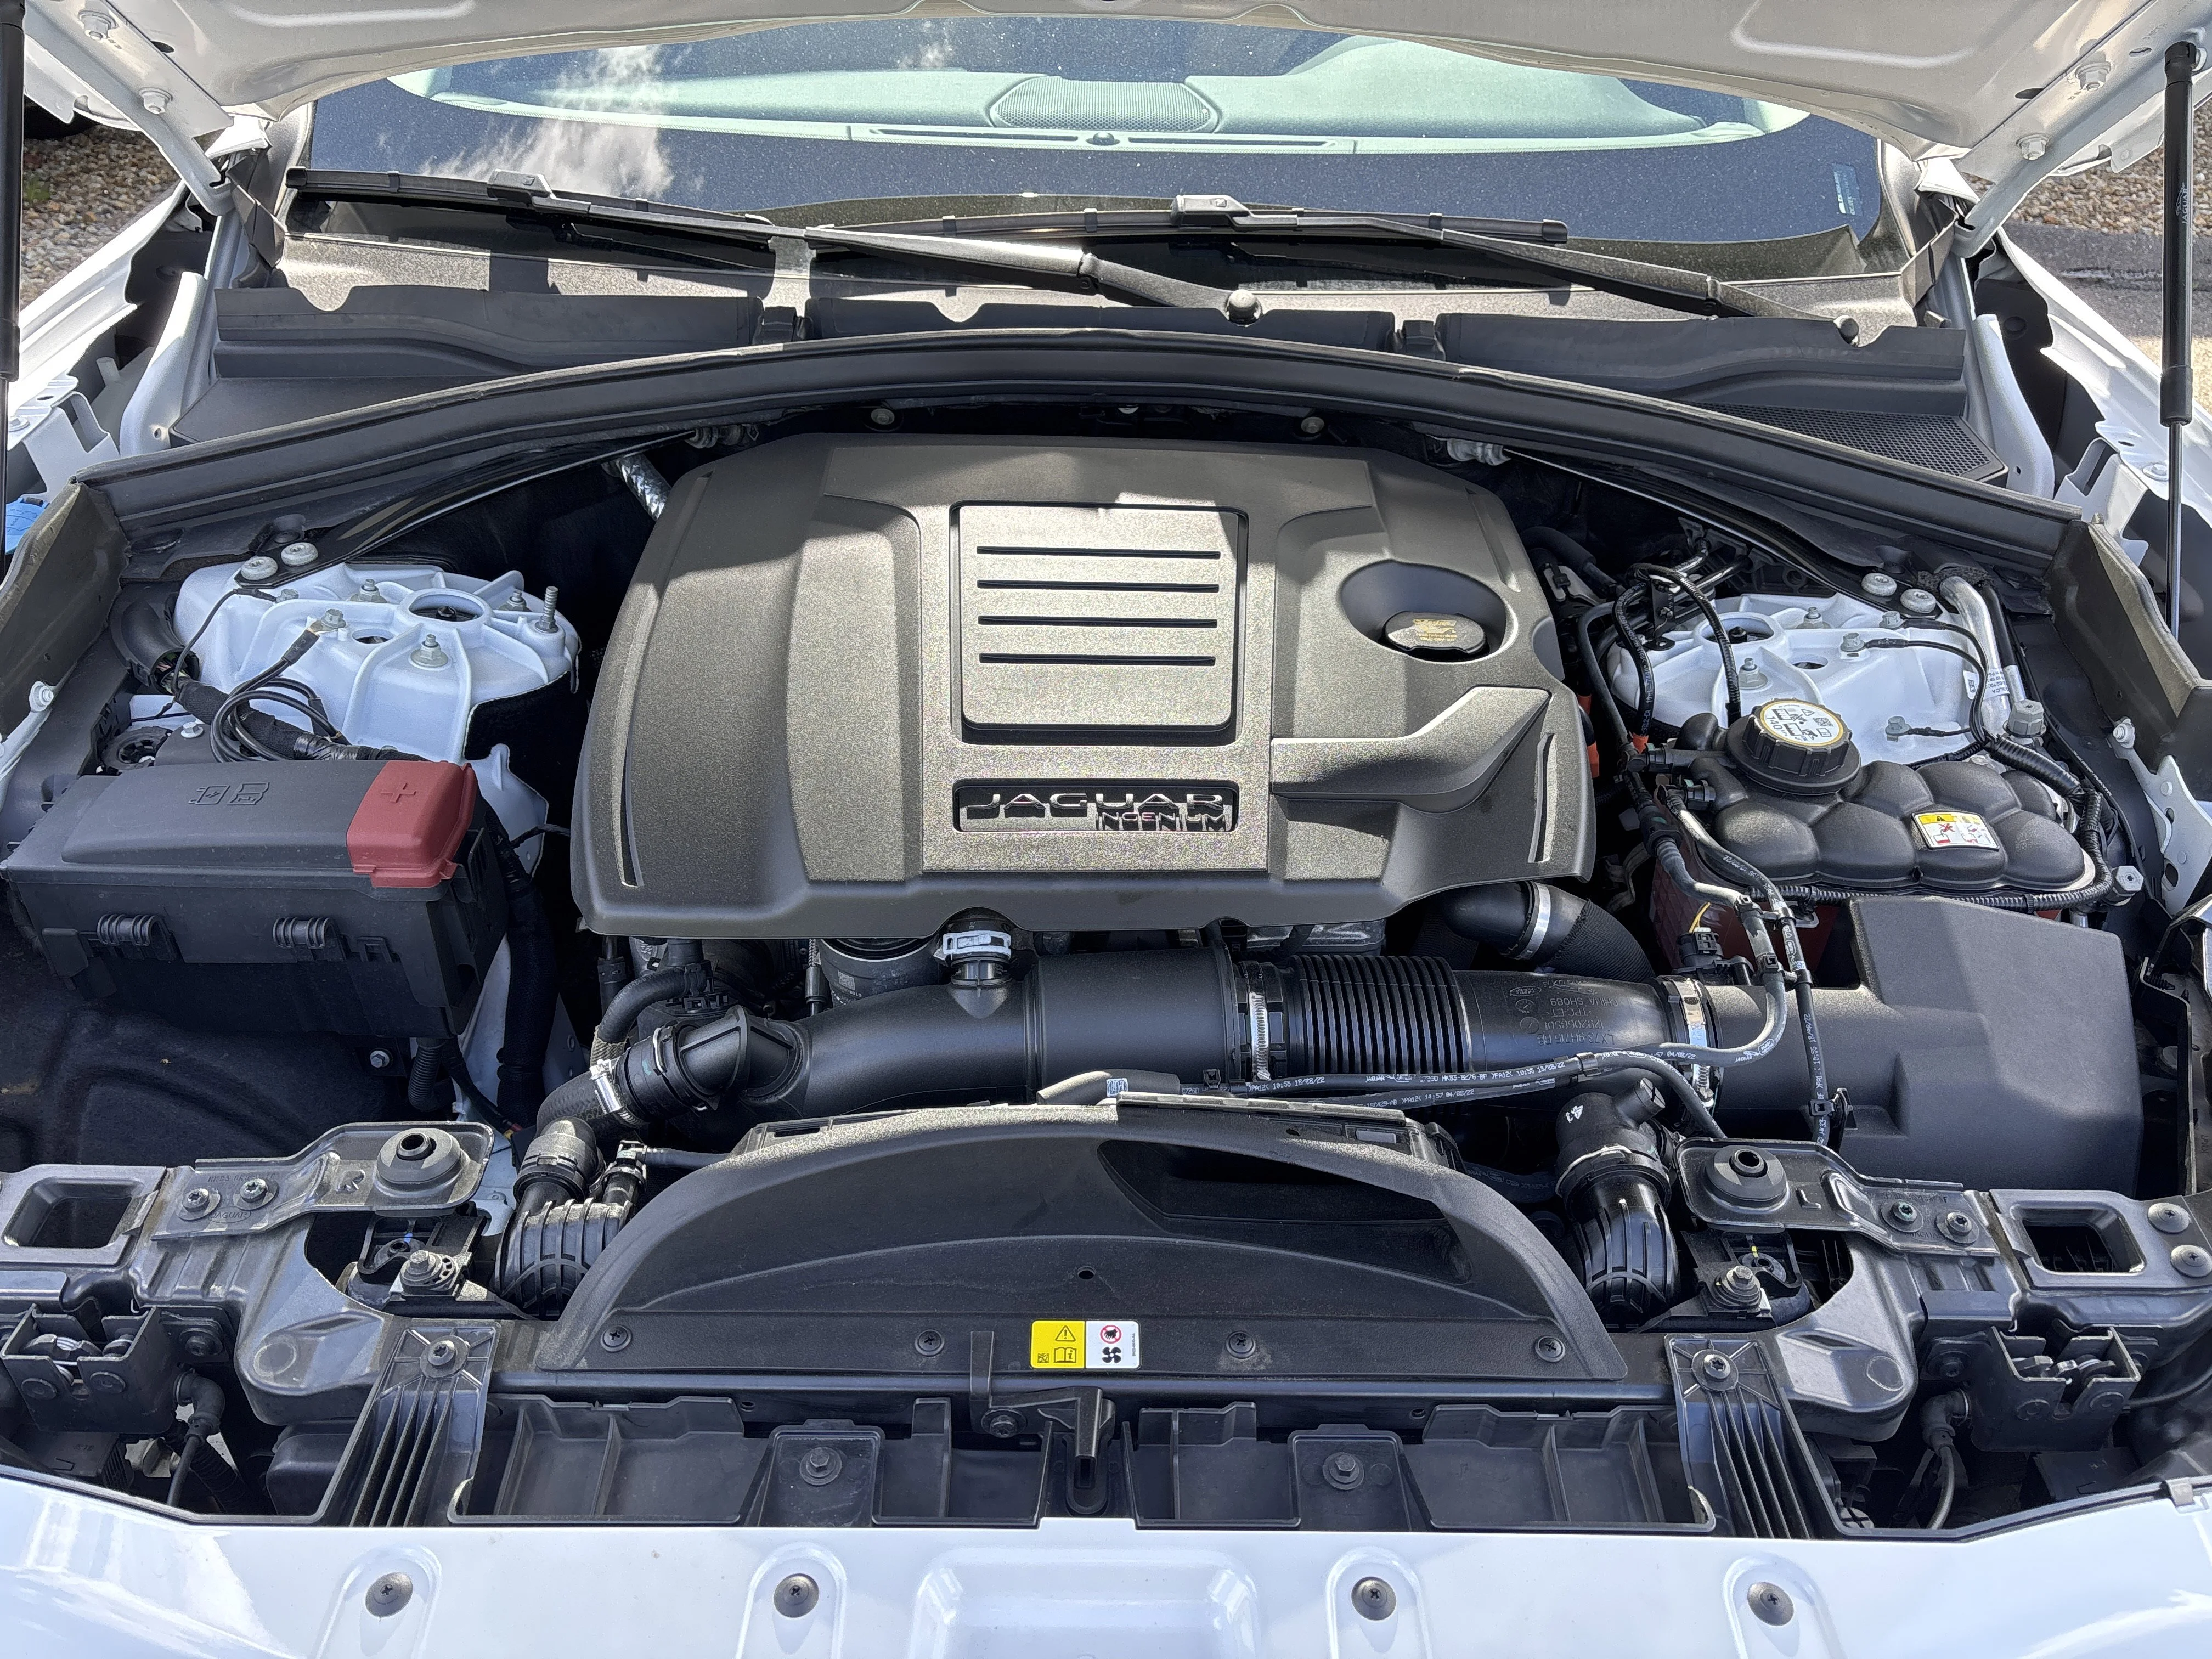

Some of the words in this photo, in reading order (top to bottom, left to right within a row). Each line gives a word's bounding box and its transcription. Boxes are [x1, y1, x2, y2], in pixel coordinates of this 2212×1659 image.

[965, 792, 1224, 810] JAGUAR
[1516, 1067, 1534, 1077] 10:55
[1272, 1080, 1291, 1090] 10:55
[1424, 1092, 1444, 1100] 14:57
[212, 1211, 248, 1219] JAGUAR
